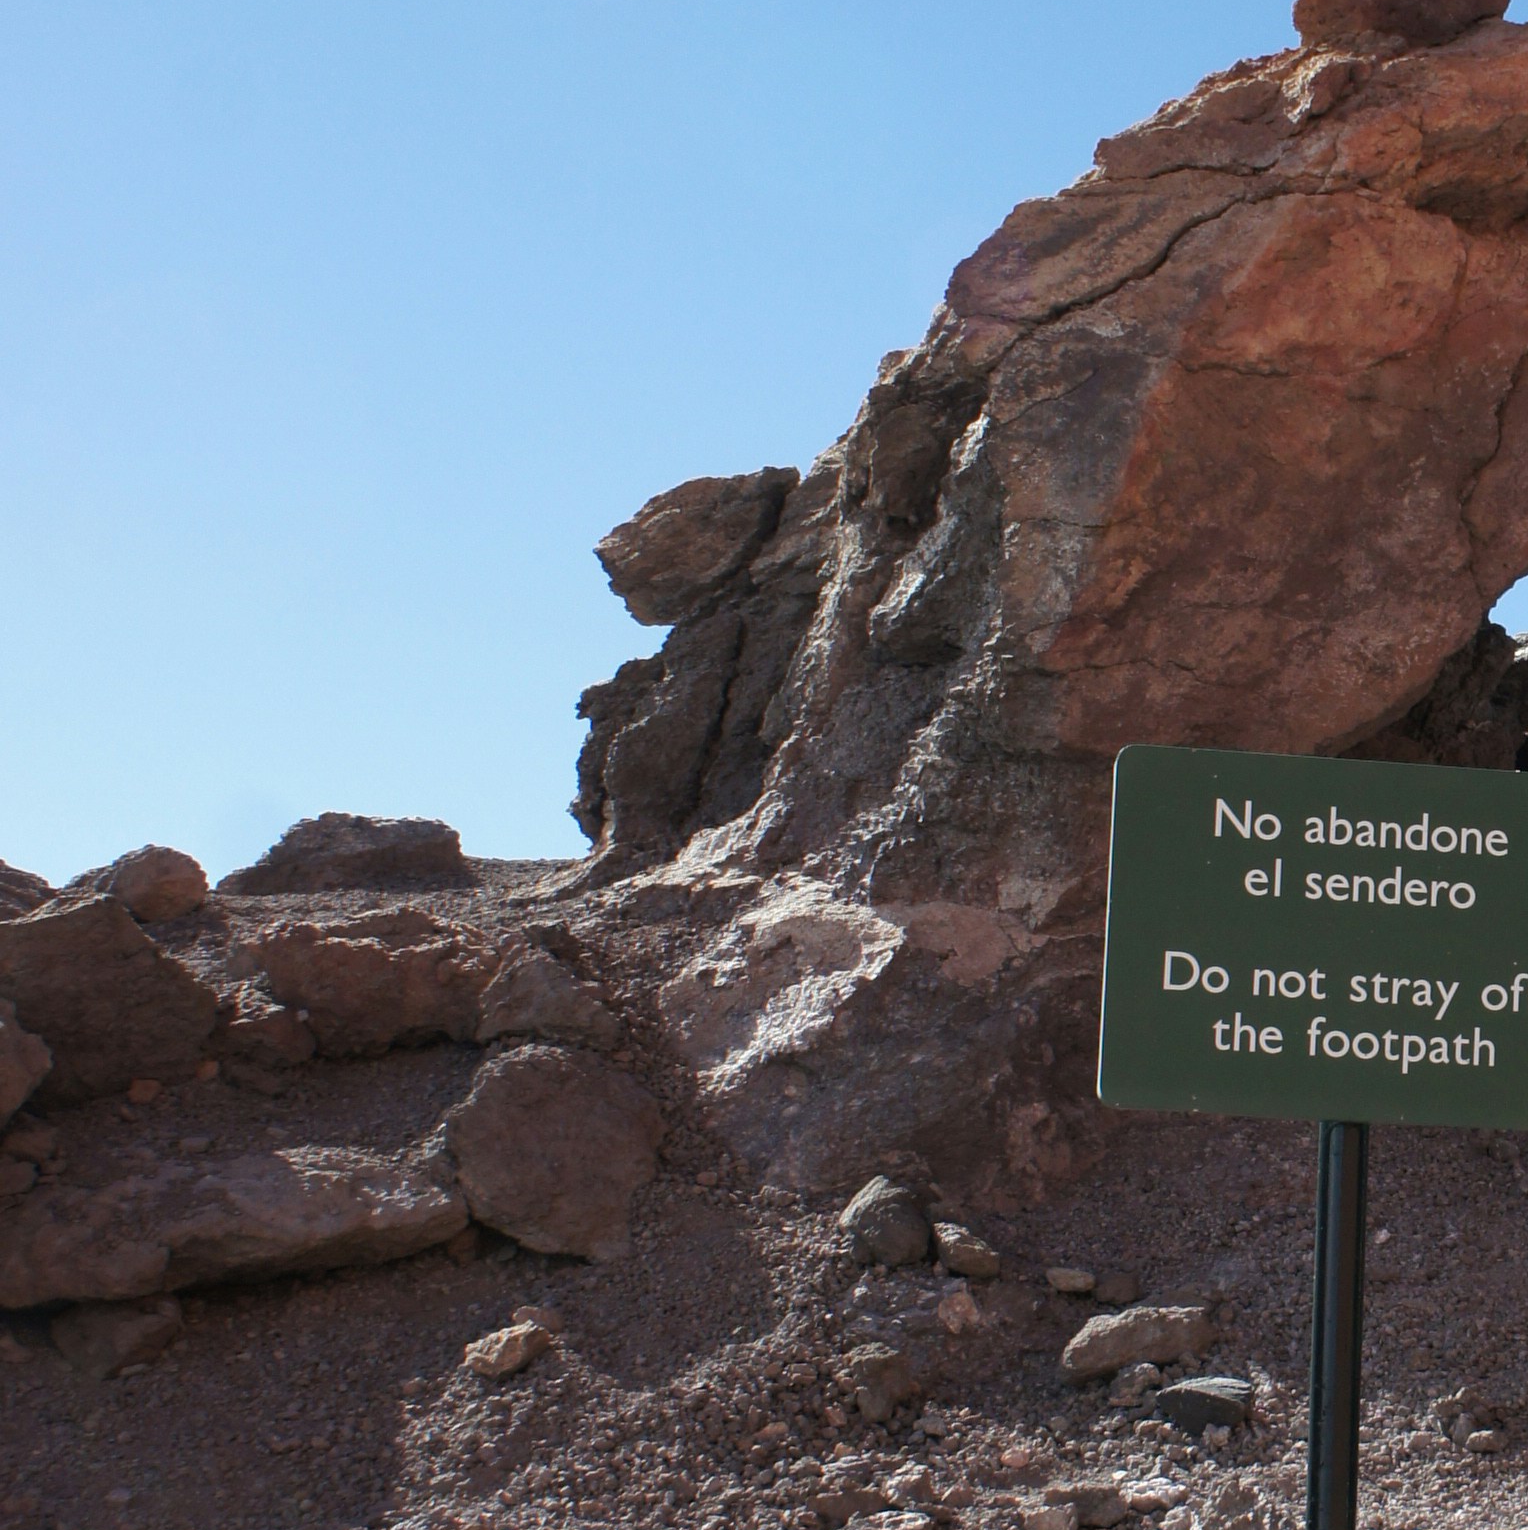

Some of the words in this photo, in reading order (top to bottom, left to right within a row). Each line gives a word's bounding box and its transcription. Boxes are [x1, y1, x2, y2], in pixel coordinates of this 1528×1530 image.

[1213, 797, 1282, 841] No
[1303, 806, 1510, 857] abandone
[1244, 858, 1283, 898] el
[1304, 866, 1477, 910] sendero
[1162, 949, 1230, 994] Do
[1252, 968, 1327, 1000] not
[1348, 972, 1460, 1021] stray
[1212, 1011, 1284, 1054] the
[1306, 1016, 1496, 1075] footpath
